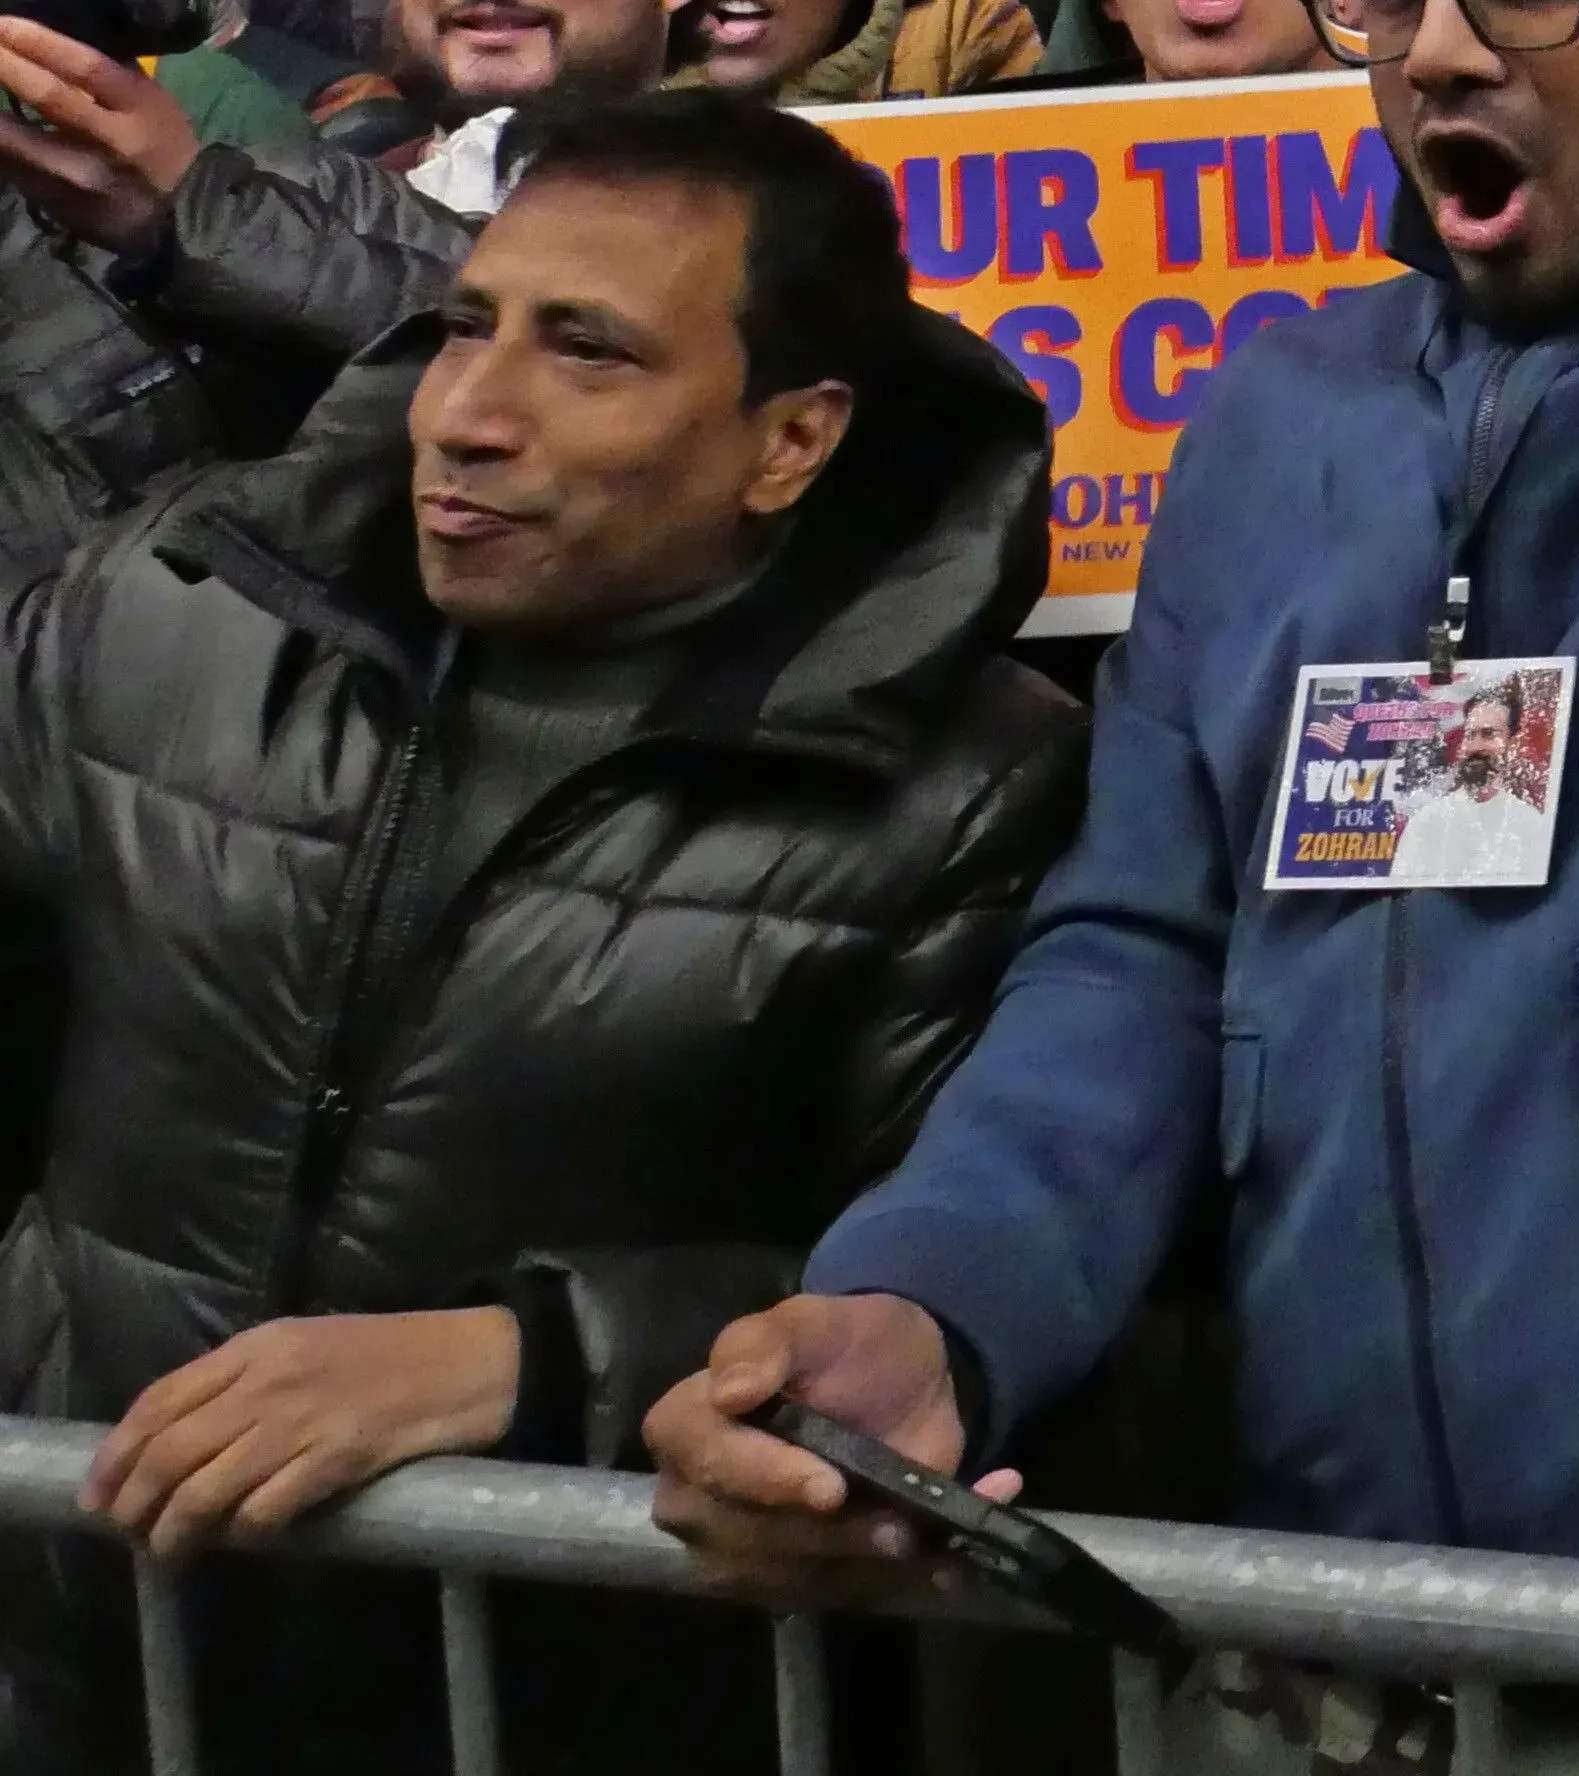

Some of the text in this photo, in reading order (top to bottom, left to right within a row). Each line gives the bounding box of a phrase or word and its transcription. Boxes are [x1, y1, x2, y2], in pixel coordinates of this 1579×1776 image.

[894, 127, 1401, 291] UR TIM
[1062, 540, 1131, 563] NEW
[1304, 758, 1407, 804] VOTE
[1332, 807, 1375, 827] FOR
[1295, 831, 1397, 862] ZOHRAN
